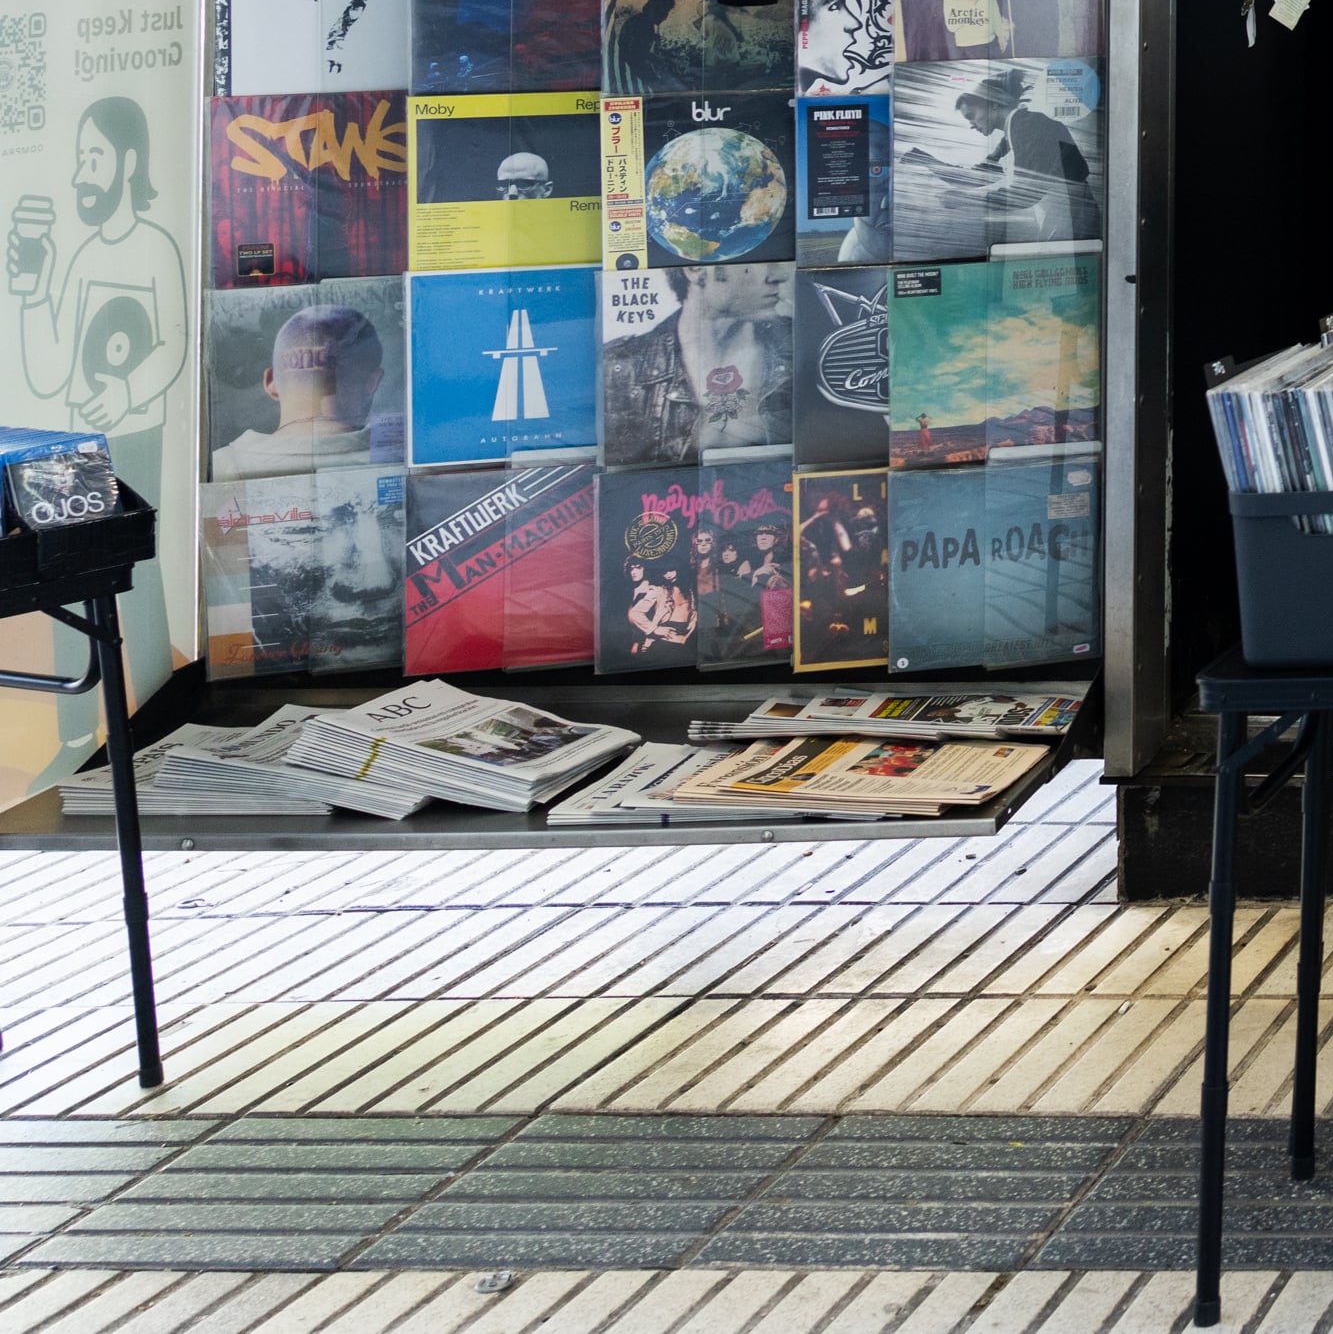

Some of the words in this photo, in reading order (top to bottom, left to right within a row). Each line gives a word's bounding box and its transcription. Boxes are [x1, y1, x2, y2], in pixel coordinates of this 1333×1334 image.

[949, 7, 985, 18] Arctic
[947, 14, 990, 27] monkeys
[415, 103, 456, 117] Moby
[691, 100, 732, 122] blur
[813, 109, 835, 121] PINK
[836, 109, 863, 121] FLOYD
[611, 126, 621, 155] ブラー
[478, 285, 562, 296] KRAFTWERK
[621, 276, 650, 291] THE
[611, 292, 659, 307] BLACK
[615, 308, 656, 324] KEYS
[480, 432, 564, 444] AUTOBAHN
[31, 490, 105, 526] OJOS
[410, 480, 530, 566] KRAFTWERK
[900, 527, 981, 573] PAPA
[366, 695, 433, 725] ABC
